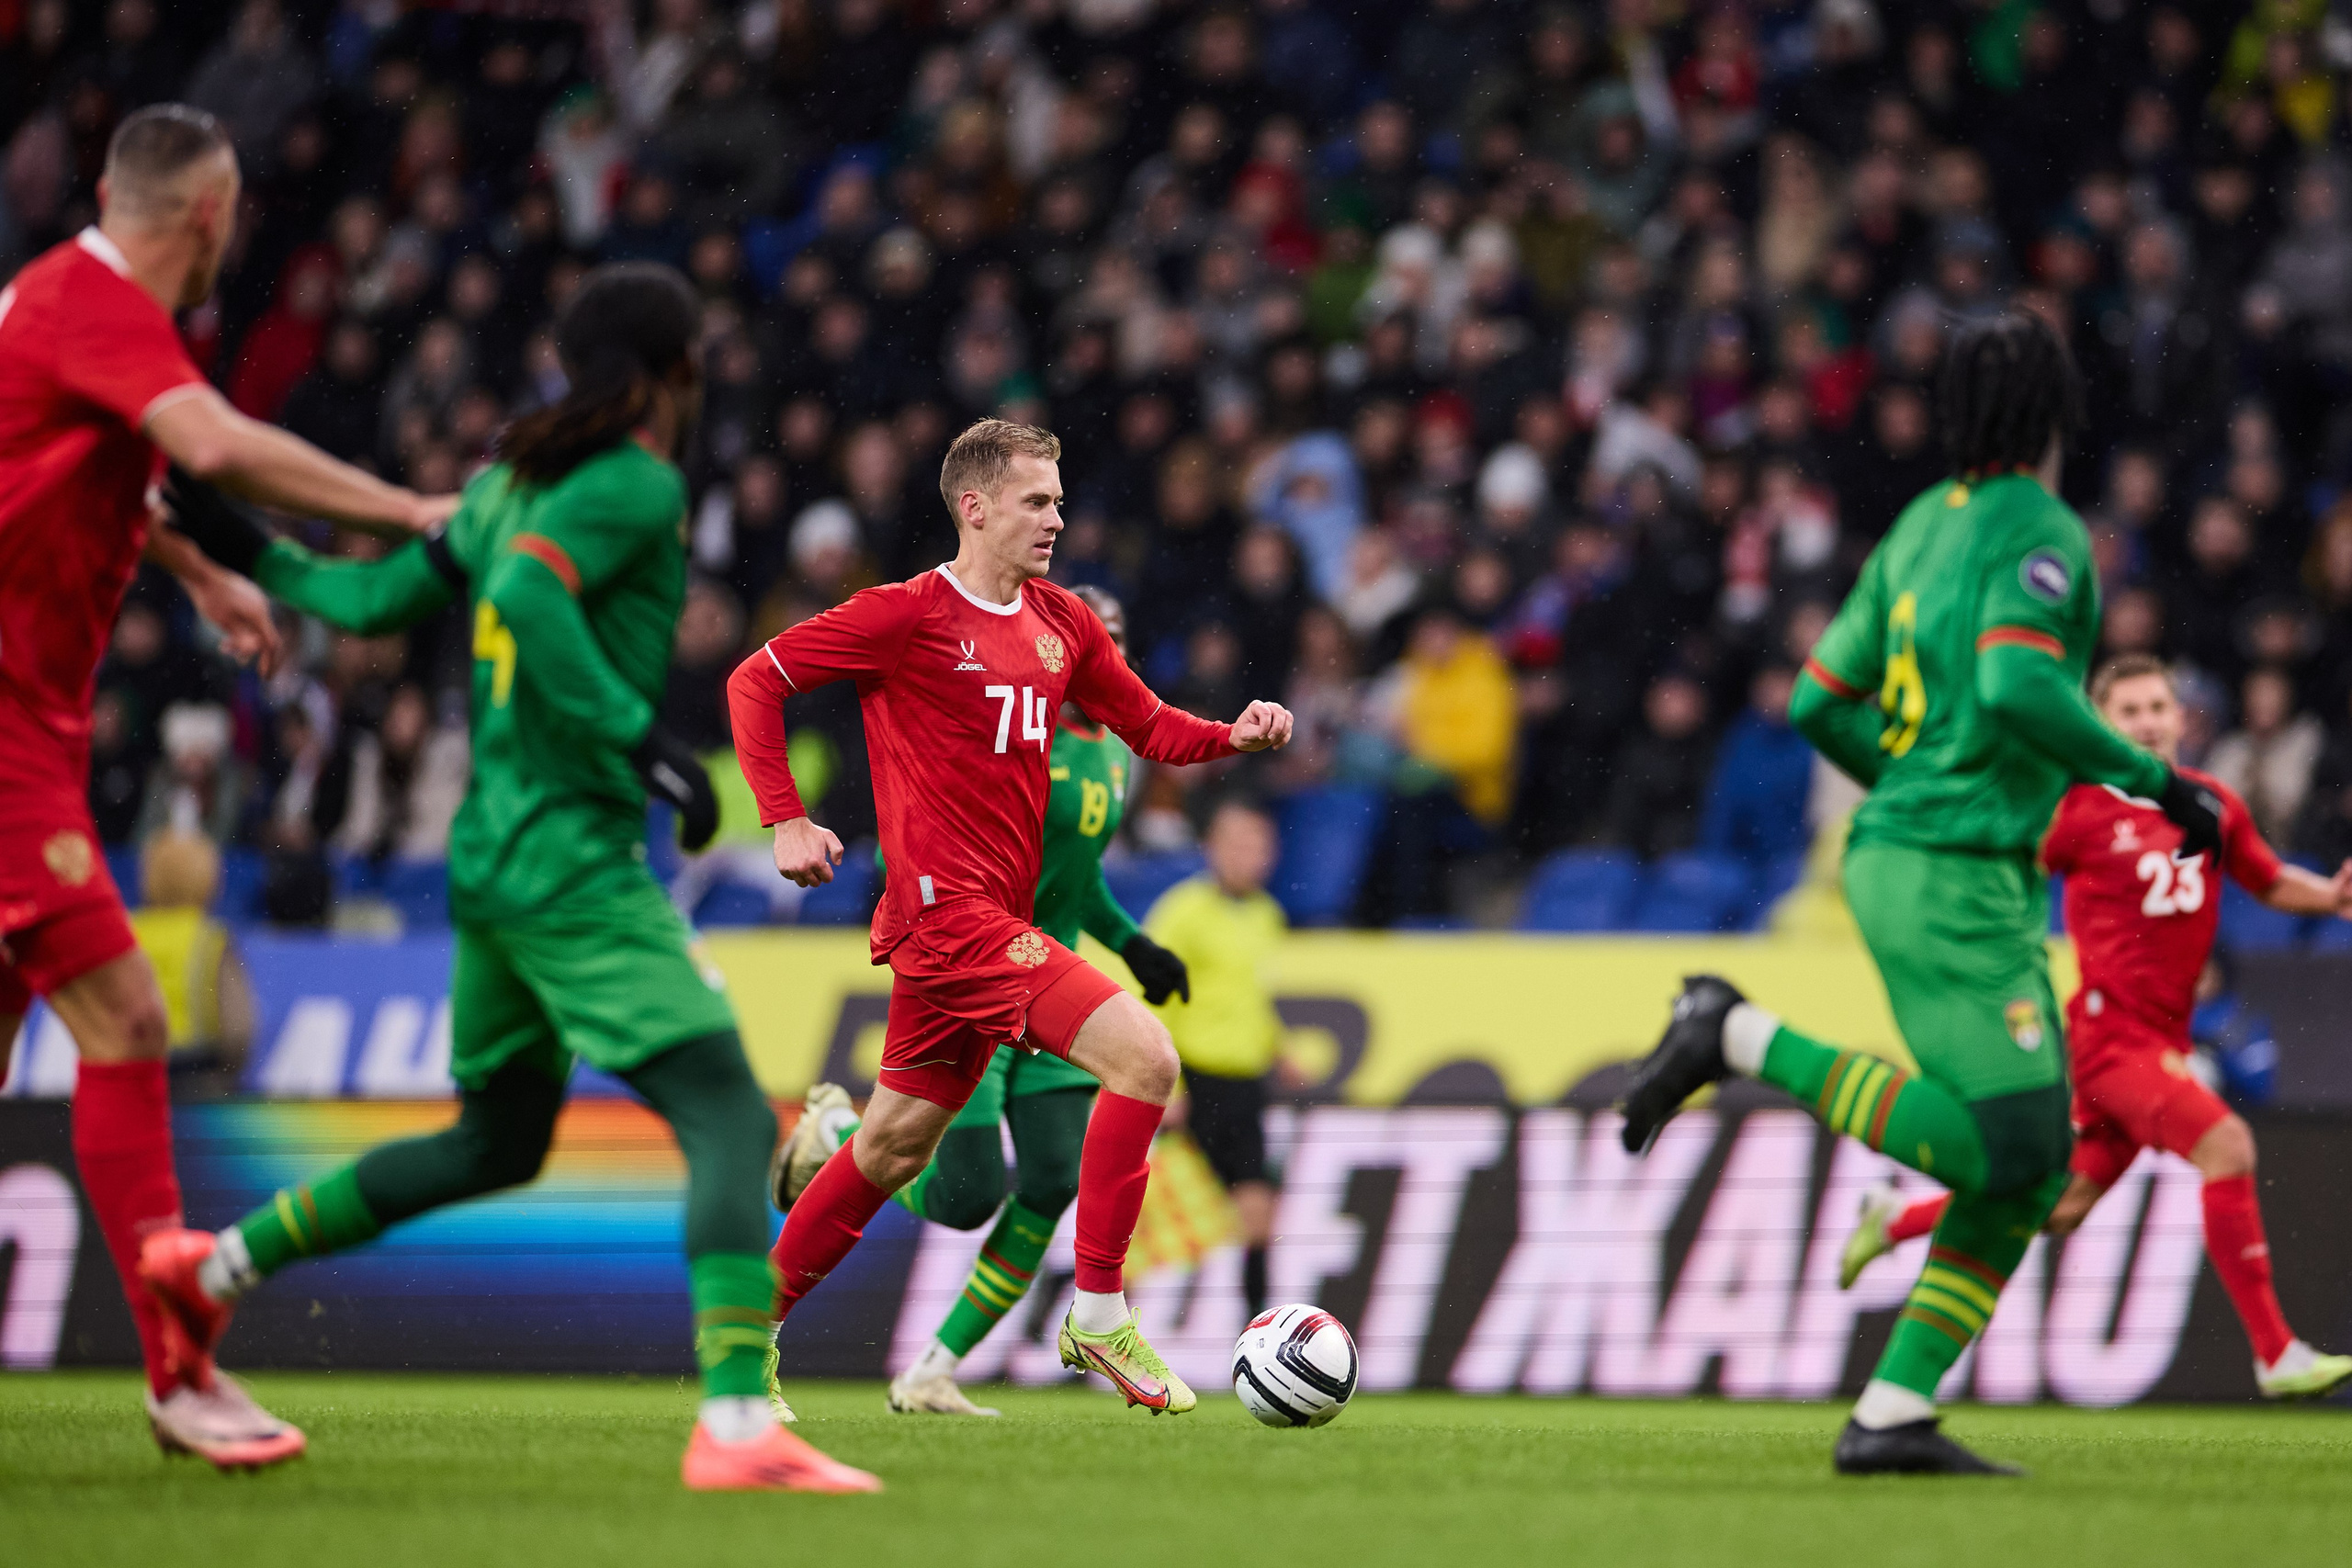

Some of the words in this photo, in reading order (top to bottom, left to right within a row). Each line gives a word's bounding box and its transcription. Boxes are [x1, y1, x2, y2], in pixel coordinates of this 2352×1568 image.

[953, 661, 988, 671] JÖGEL
[985, 684, 1047, 754] 74
[1078, 777, 1109, 838] 19
[2136, 850, 2206, 918] 23
